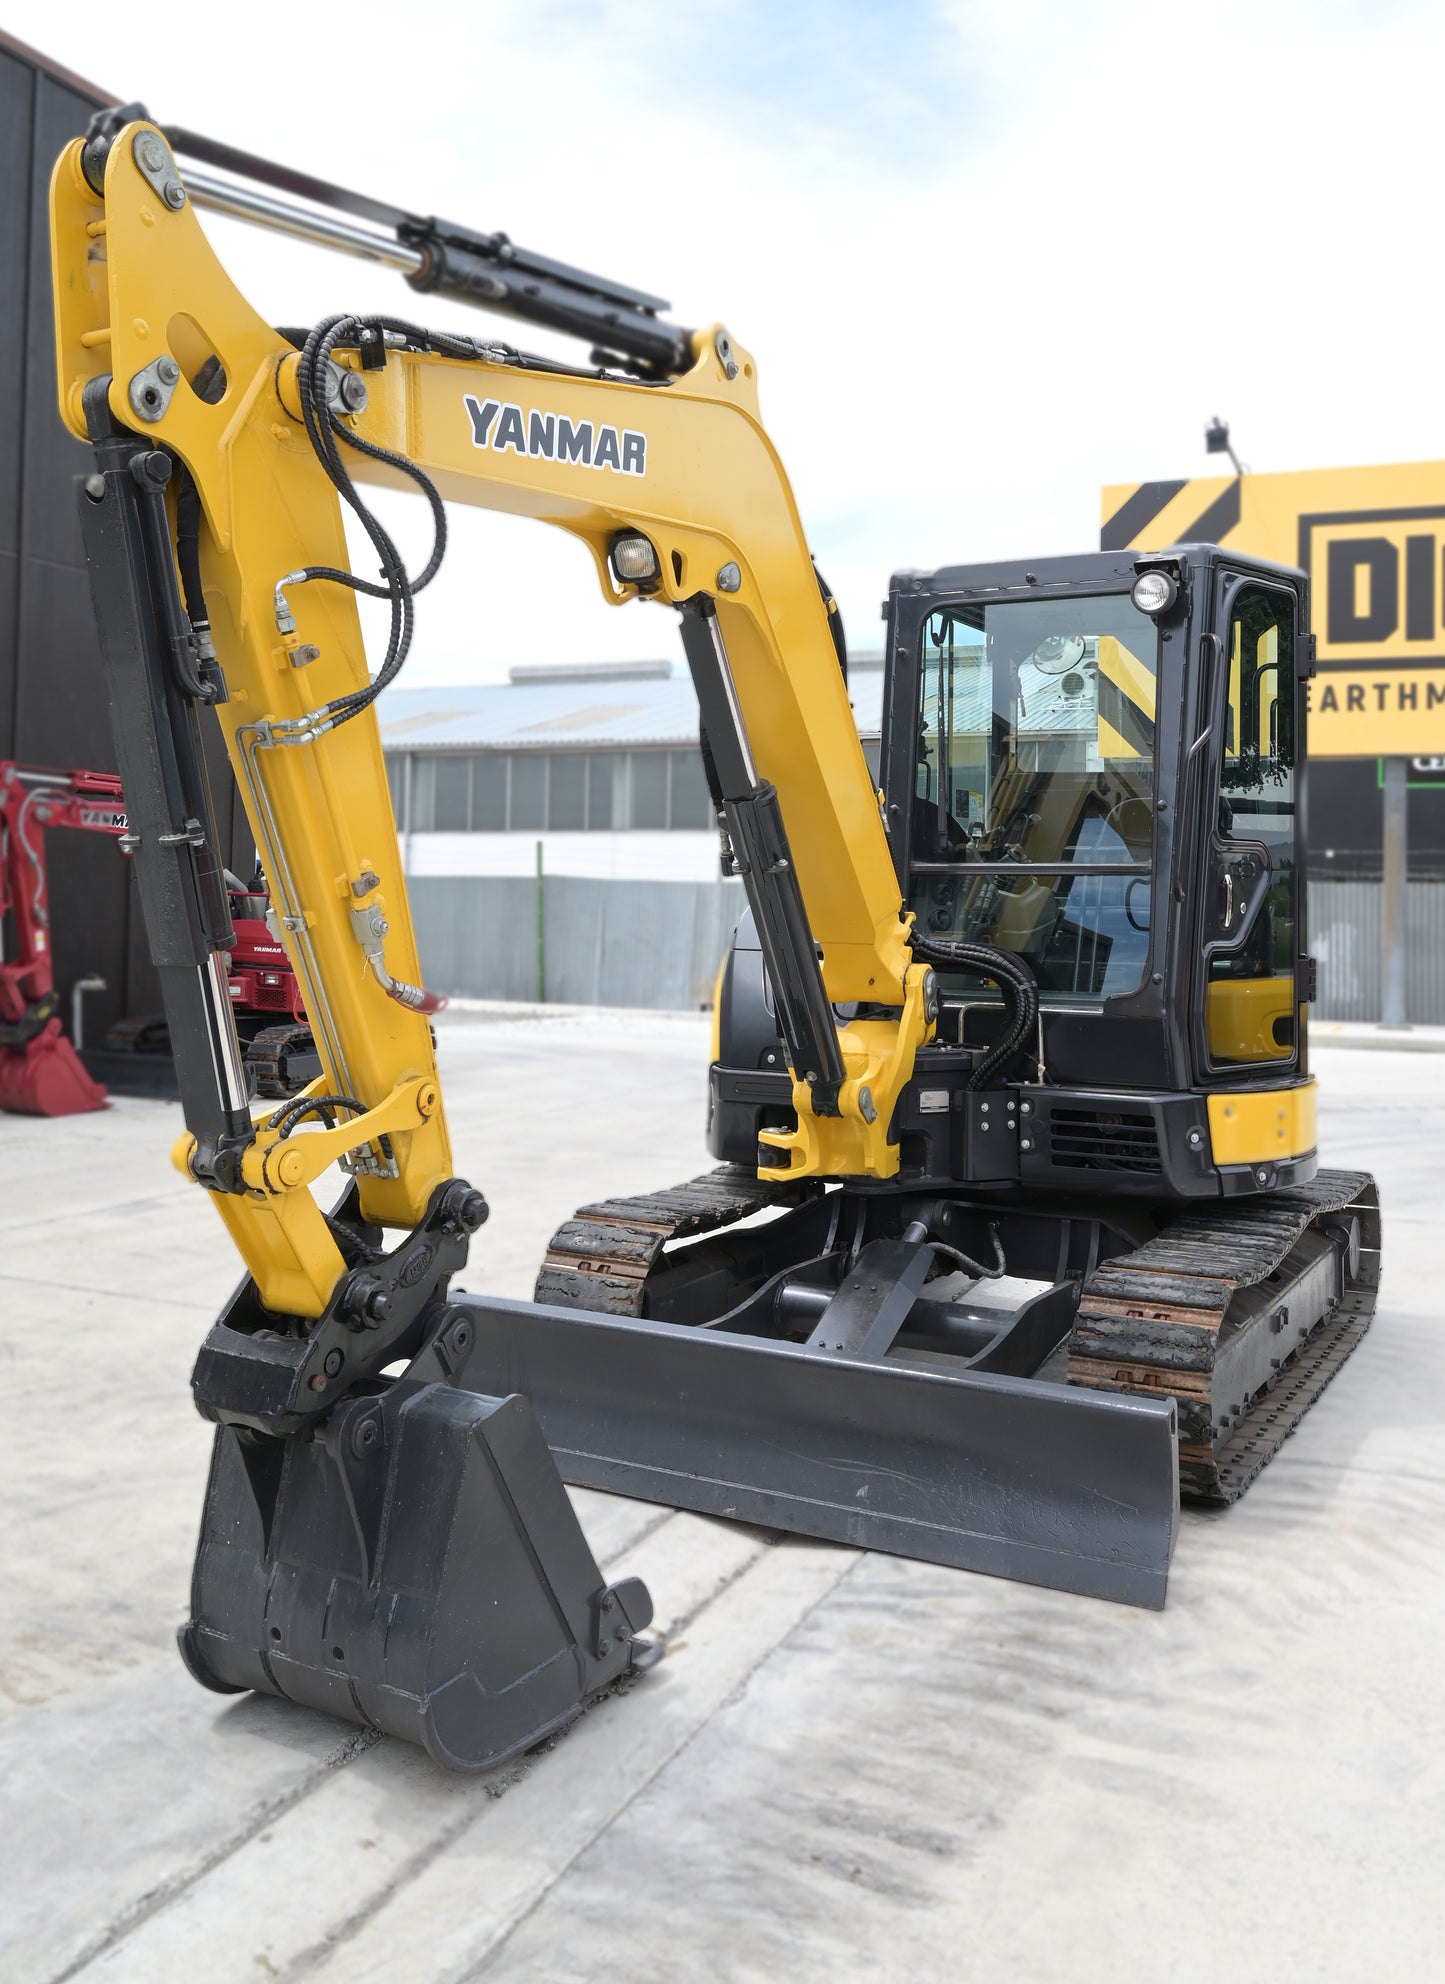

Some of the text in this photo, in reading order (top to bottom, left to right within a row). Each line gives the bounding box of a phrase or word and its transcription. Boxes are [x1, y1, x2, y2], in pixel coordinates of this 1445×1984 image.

[464, 395, 645, 476] YANMAR
[1327, 534, 1445, 645] DI
[1305, 682, 1445, 713] ARTHM
[82, 810, 129, 828] YANM
[254, 946, 282, 954] YANMAR
